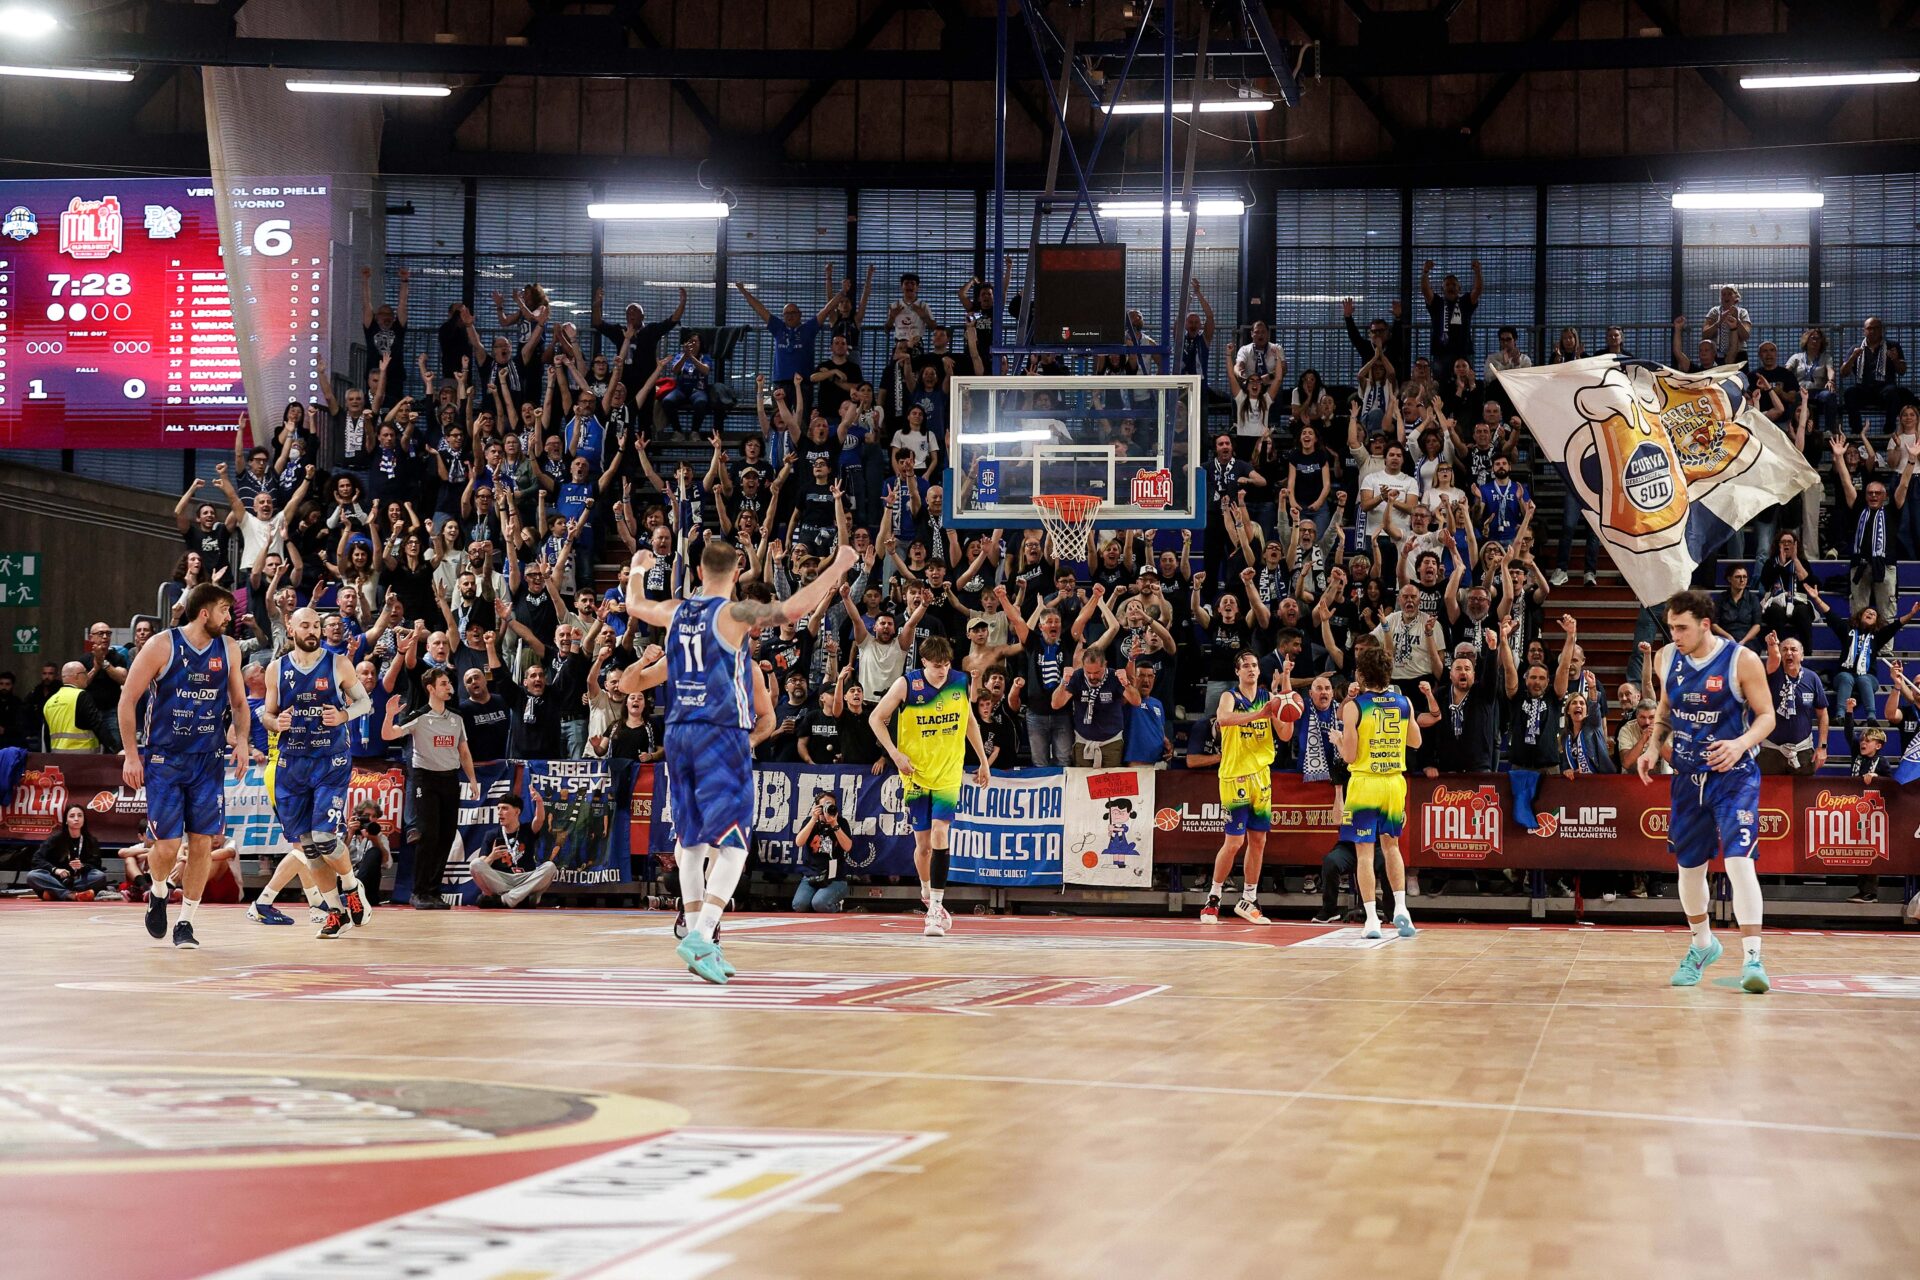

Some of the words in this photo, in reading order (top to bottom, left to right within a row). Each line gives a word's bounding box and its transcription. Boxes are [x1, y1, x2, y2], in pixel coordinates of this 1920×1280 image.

[253, 187, 279, 196] CBD
[283, 187, 326, 196] PIELLE
[234, 201, 285, 209] VORNO
[63, 213, 120, 250] ITALIA
[48, 273, 132, 296] 7:28
[177, 272, 185, 280] 1
[176, 285, 185, 293] 3
[28, 379, 48, 399] 1
[123, 378, 146, 399] 0
[1676, 417, 1708, 438] PIELLE
[1630, 453, 1666, 475] CURVA
[1133, 480, 1171, 502] ITALIA
[1640, 481, 1669, 503] SUD
[179, 645, 184, 656] 1
[679, 633, 704, 673] 11
[284, 670, 295, 680] 99
[1675, 660, 1683, 672] 3
[291, 706, 323, 717] eroDo
[935, 701, 943, 711] 5
[473, 710, 507, 725] REBELS
[1372, 708, 1401, 734] 12
[1672, 708, 1720, 724] VeroDol
[530, 773, 563, 791] PER
[1434, 786, 1474, 806] Coppa
[1818, 791, 1858, 810] Coppa
[327, 808, 342, 824] 99
[1271, 810, 1303, 826] OLD
[1559, 806, 1618, 825] LNP
[1648, 814, 1671, 833] OL
[1758, 815, 1783, 833] ST
[1424, 805, 1500, 849] ITALIA
[1808, 810, 1886, 855] ITALIA
[950, 829, 1061, 861] MOLESTA
[1740, 828, 1751, 847] 3
[579, 870, 601, 884] CON
[601, 869, 621, 883] NOI
[1003, 869, 1027, 878] SUDEST
